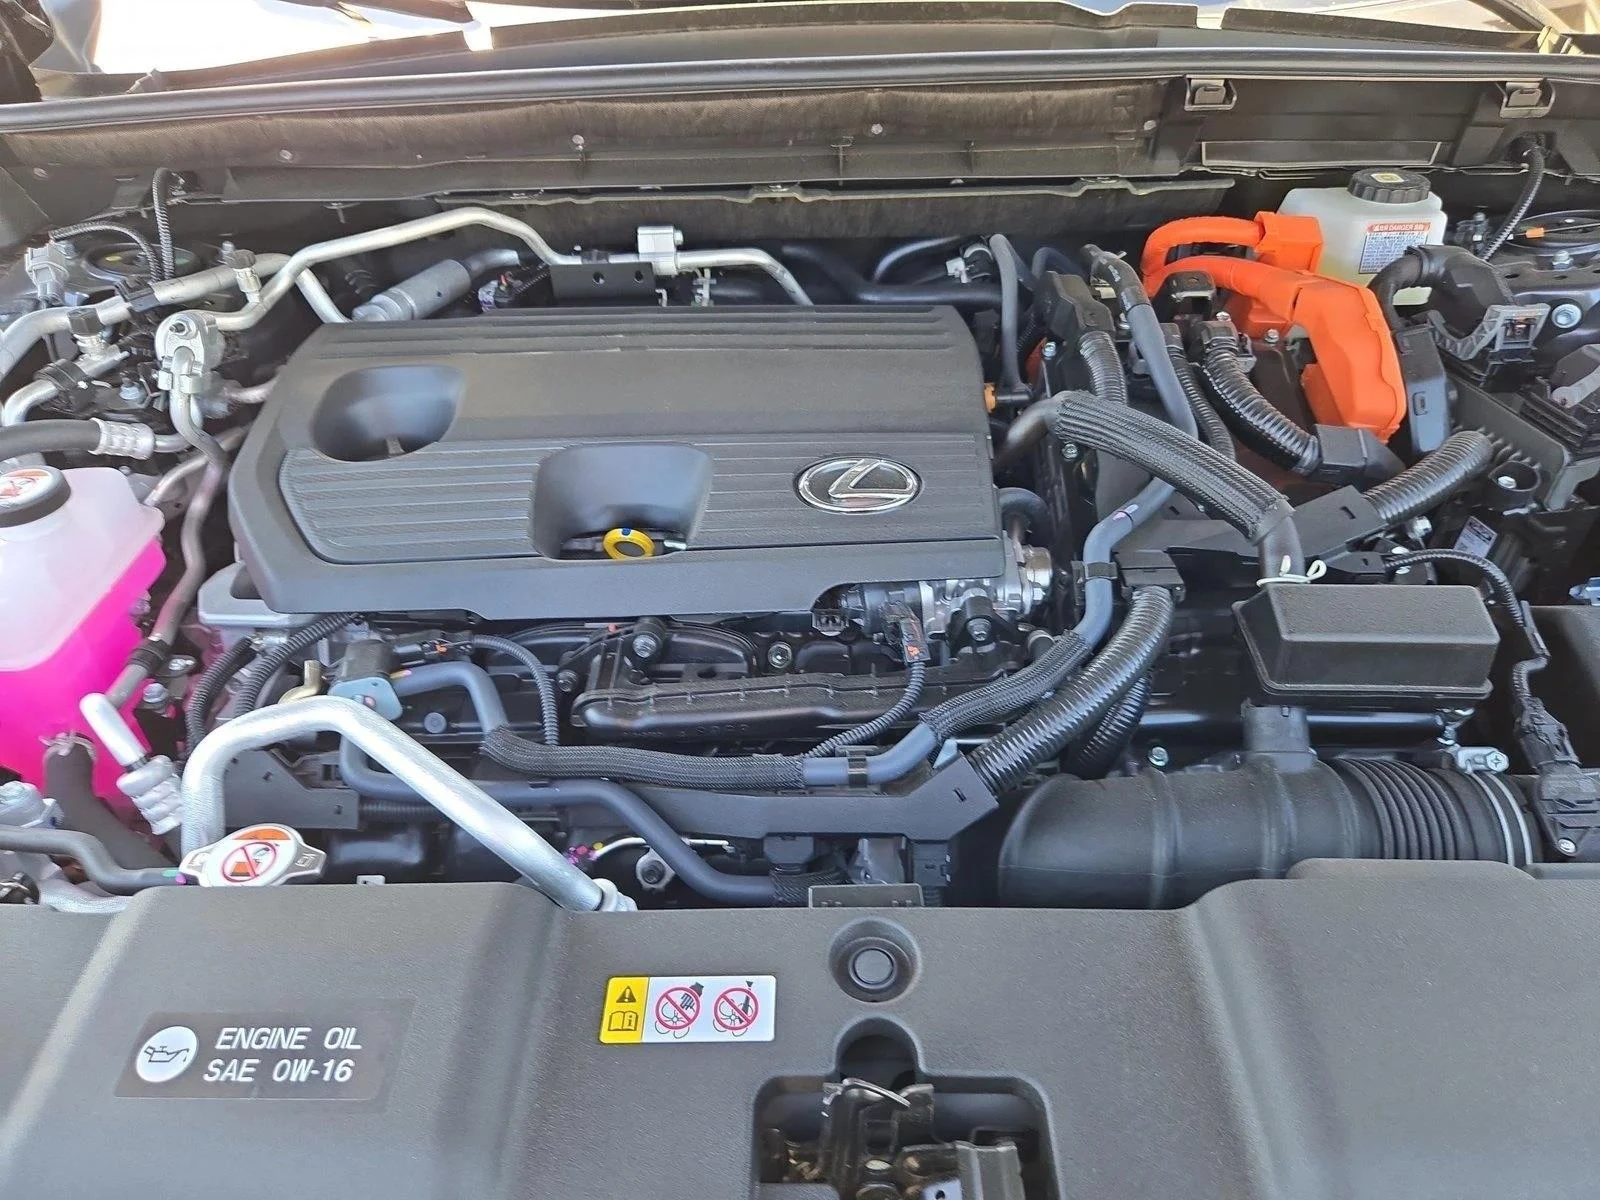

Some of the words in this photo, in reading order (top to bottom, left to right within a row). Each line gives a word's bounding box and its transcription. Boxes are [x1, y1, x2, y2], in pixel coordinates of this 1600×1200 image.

[1389, 224, 1413, 232] DANGER
[215, 1027, 311, 1049] ENGINE
[323, 1027, 362, 1049] OIL
[203, 1059, 260, 1082] SAE
[272, 1058, 355, 1082] 0W-16
